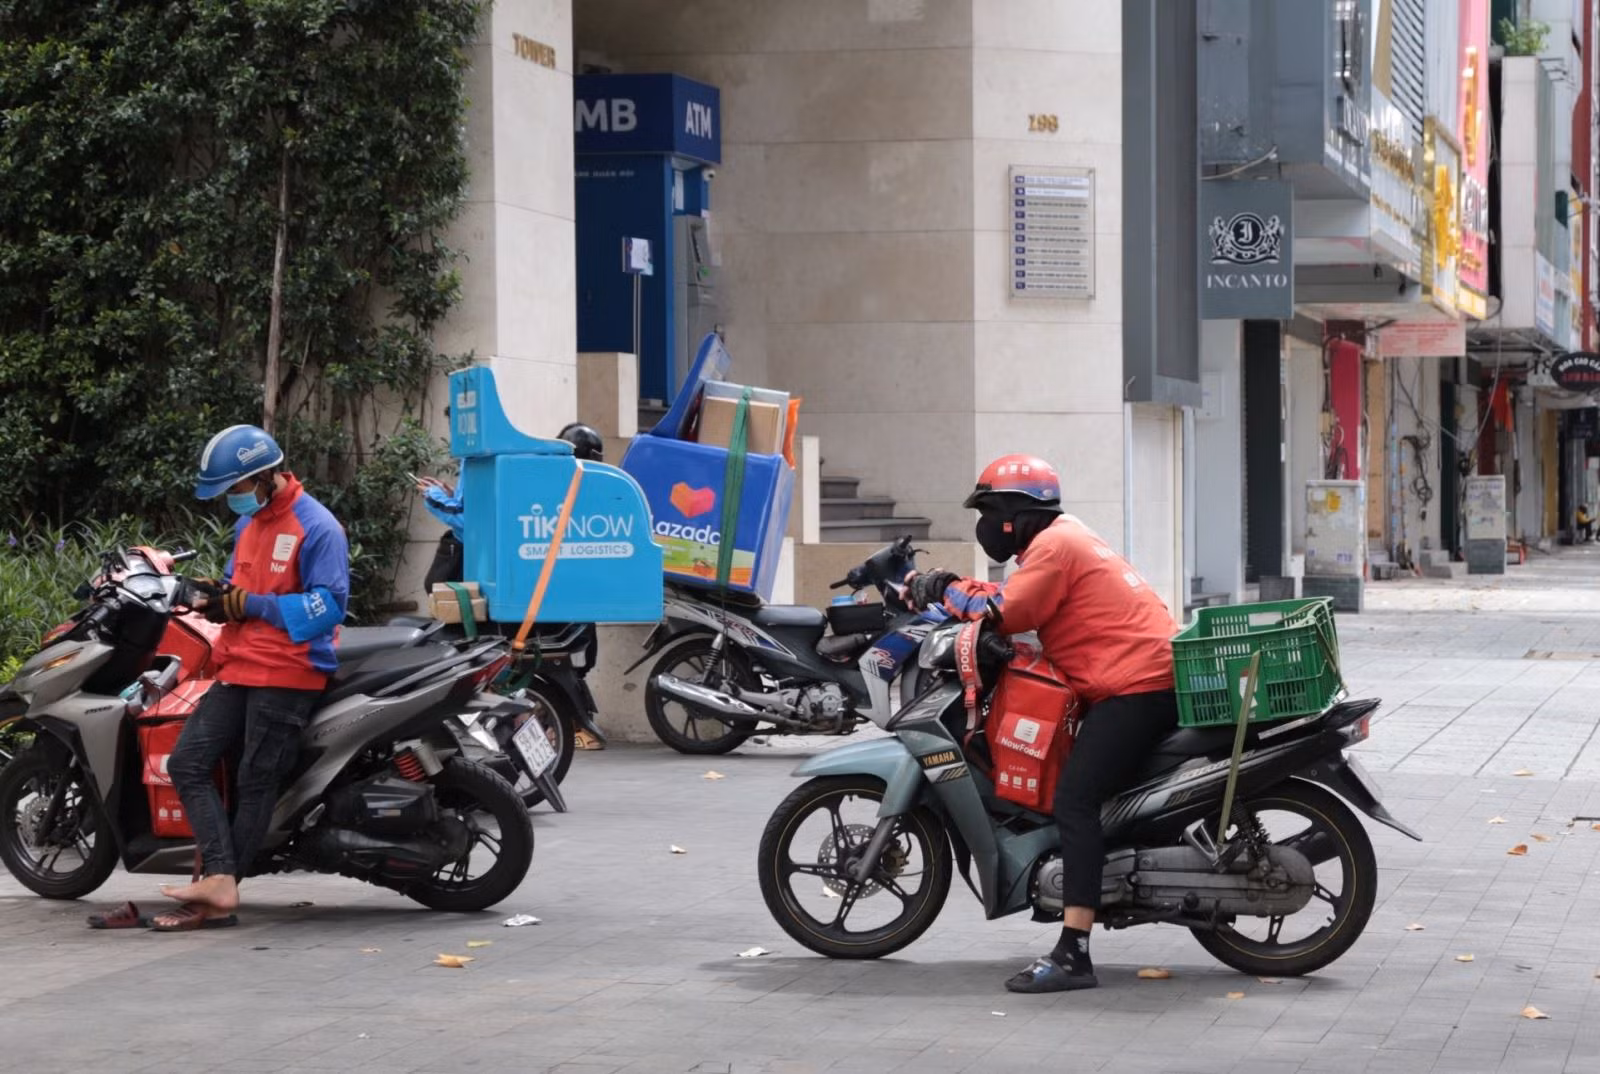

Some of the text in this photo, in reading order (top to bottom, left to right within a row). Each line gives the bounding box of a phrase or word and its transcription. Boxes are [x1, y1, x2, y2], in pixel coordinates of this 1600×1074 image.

[512, 32, 556, 69] TOWER
[574, 98, 637, 132] MB
[685, 101, 712, 140] ATM
[1207, 274, 1288, 289] INCANTO
[525, 544, 629, 556] SMAT LOGISTICS
[1001, 736, 1041, 758] NowFood
[922, 750, 956, 767] YAMAHA
